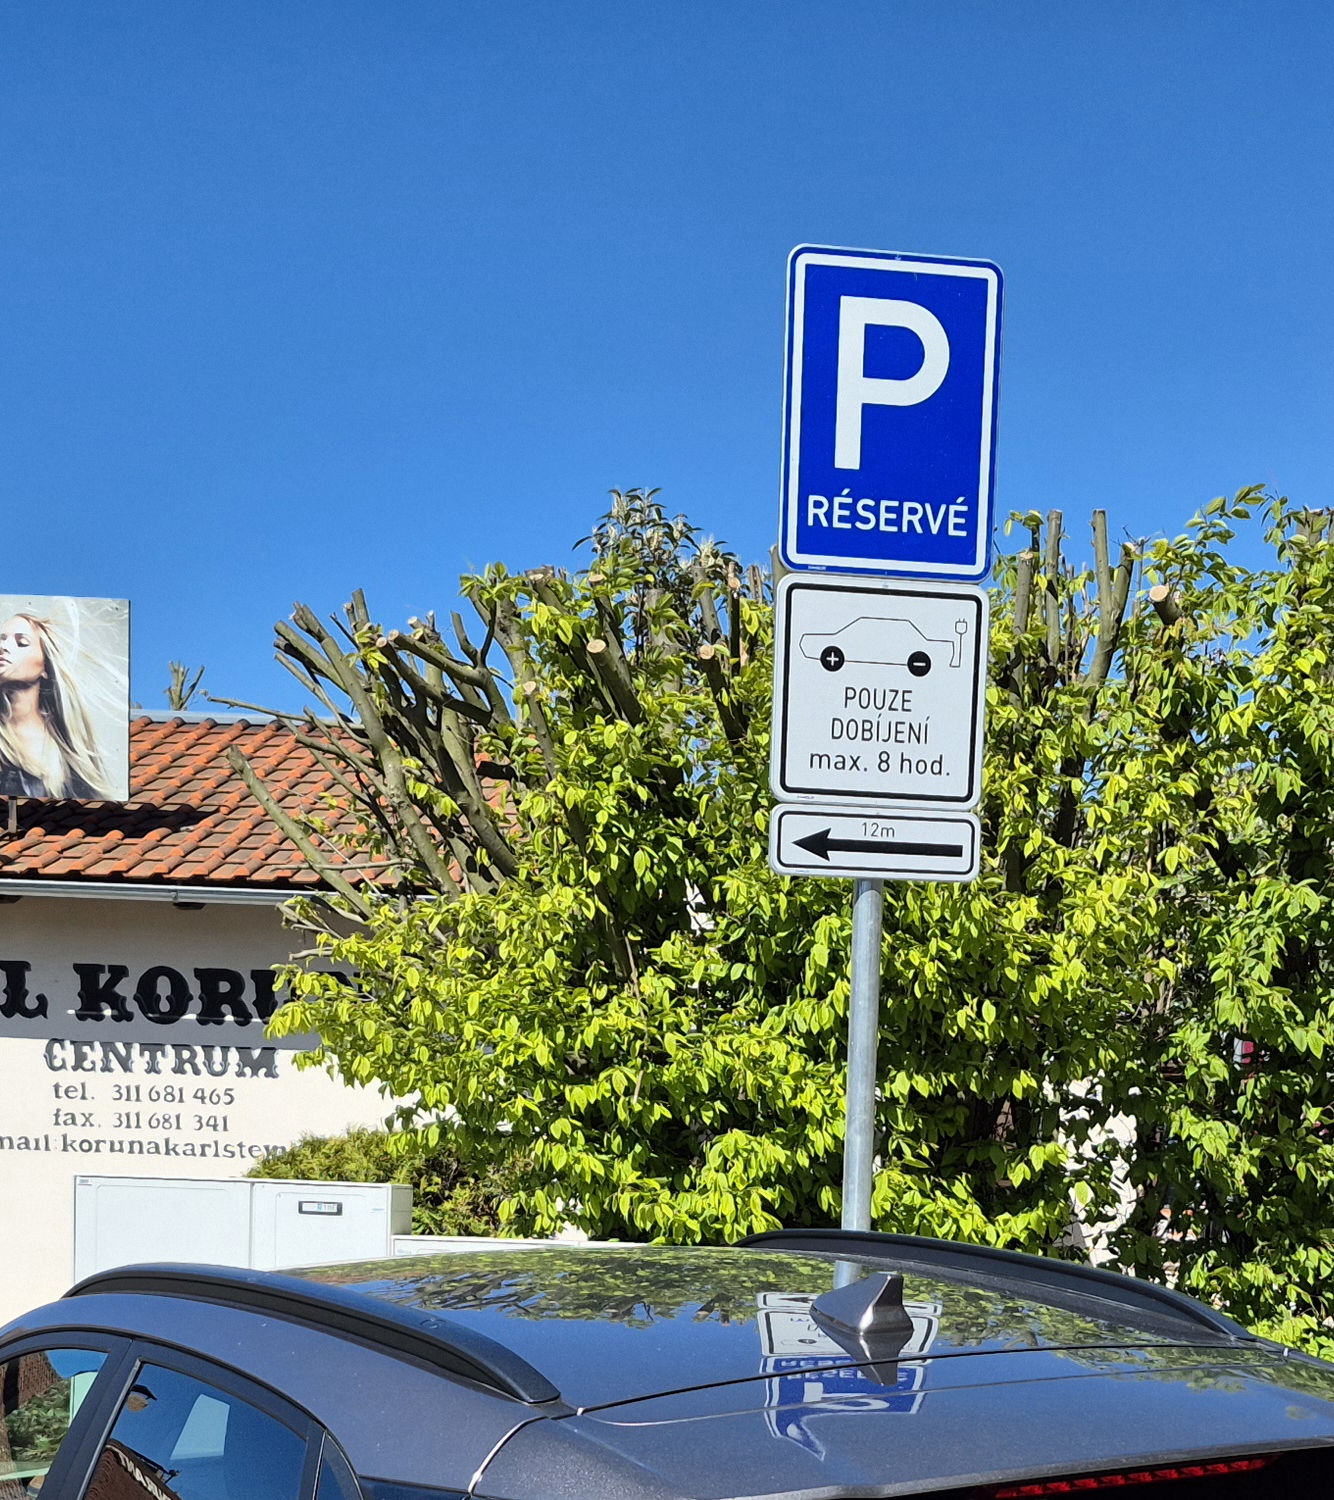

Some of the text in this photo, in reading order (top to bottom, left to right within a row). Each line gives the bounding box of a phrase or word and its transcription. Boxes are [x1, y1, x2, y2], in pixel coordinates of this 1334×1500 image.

[834, 294, 950, 470] P
[807, 488, 968, 537] RÉSERVÉ
[844, 686, 914, 713] POUZE
[831, 713, 930, 745] DOBÍJENÍ
[810, 751, 951, 777] max. 8 hod.
[862, 822, 895, 838] 12m
[43, 1038, 280, 1079] CENTRUM
[53, 1082, 236, 1106] tel. 311 681 465
[53, 1109, 229, 1132] fax. 311 681 341
